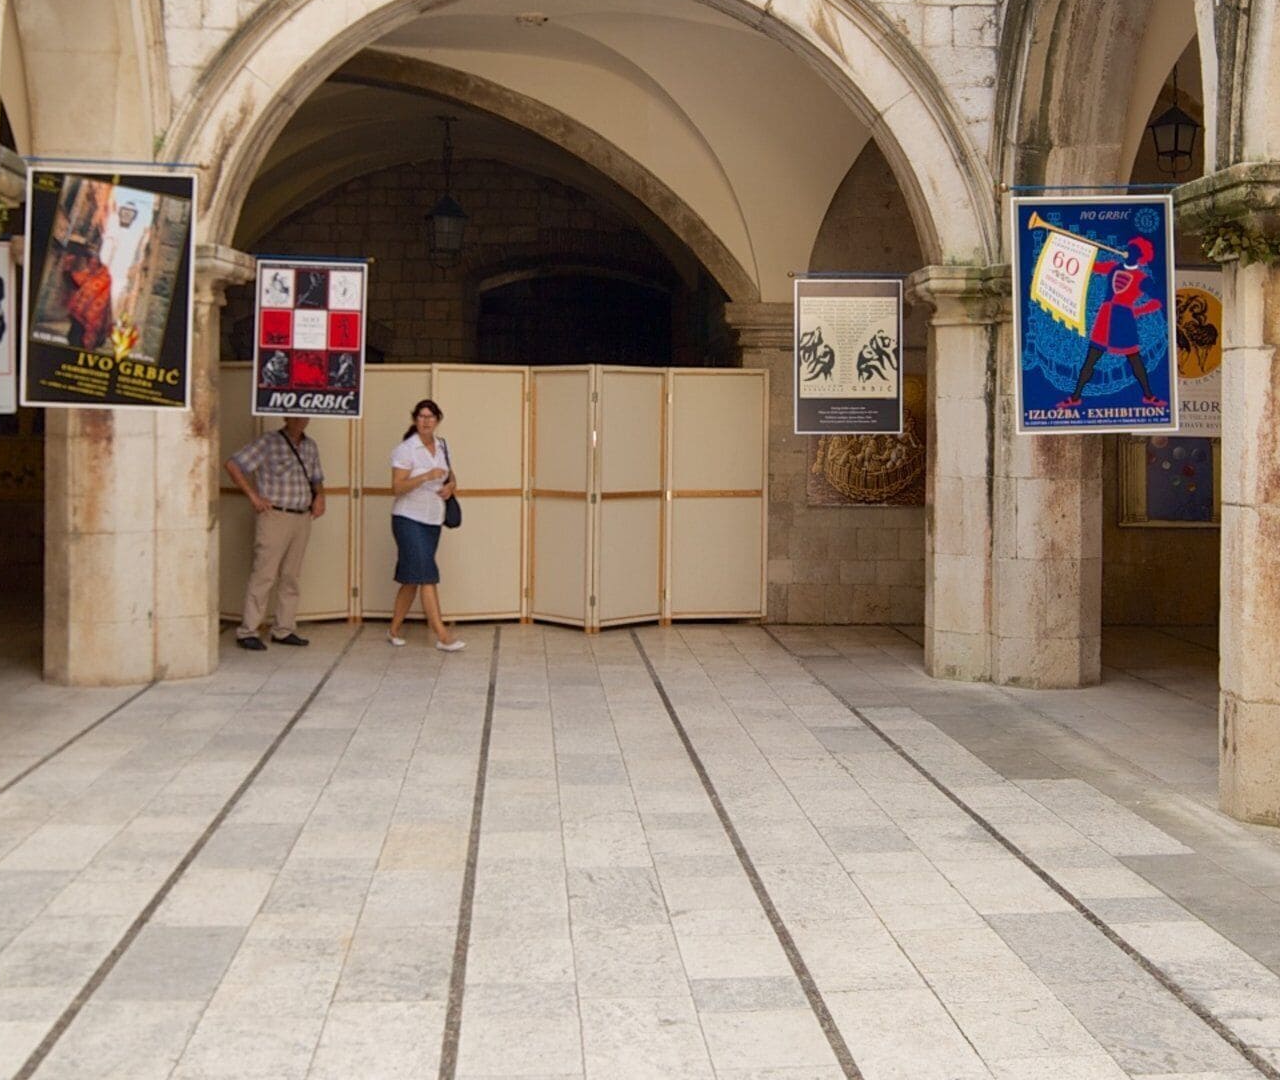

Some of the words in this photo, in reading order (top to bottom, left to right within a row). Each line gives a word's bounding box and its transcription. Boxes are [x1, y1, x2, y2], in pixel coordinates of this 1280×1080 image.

[1080, 210, 1097, 220] IVO
[1052, 250, 1080, 276] 60
[77, 352, 114, 371] IVO
[119, 361, 180, 386] GRBIĆ
[269, 391, 297, 408] IVO
[299, 391, 355, 410] GRBIĆ
[1028, 407, 1081, 420] IZLOŽBA
[1087, 405, 1166, 419] EXHIBITION
